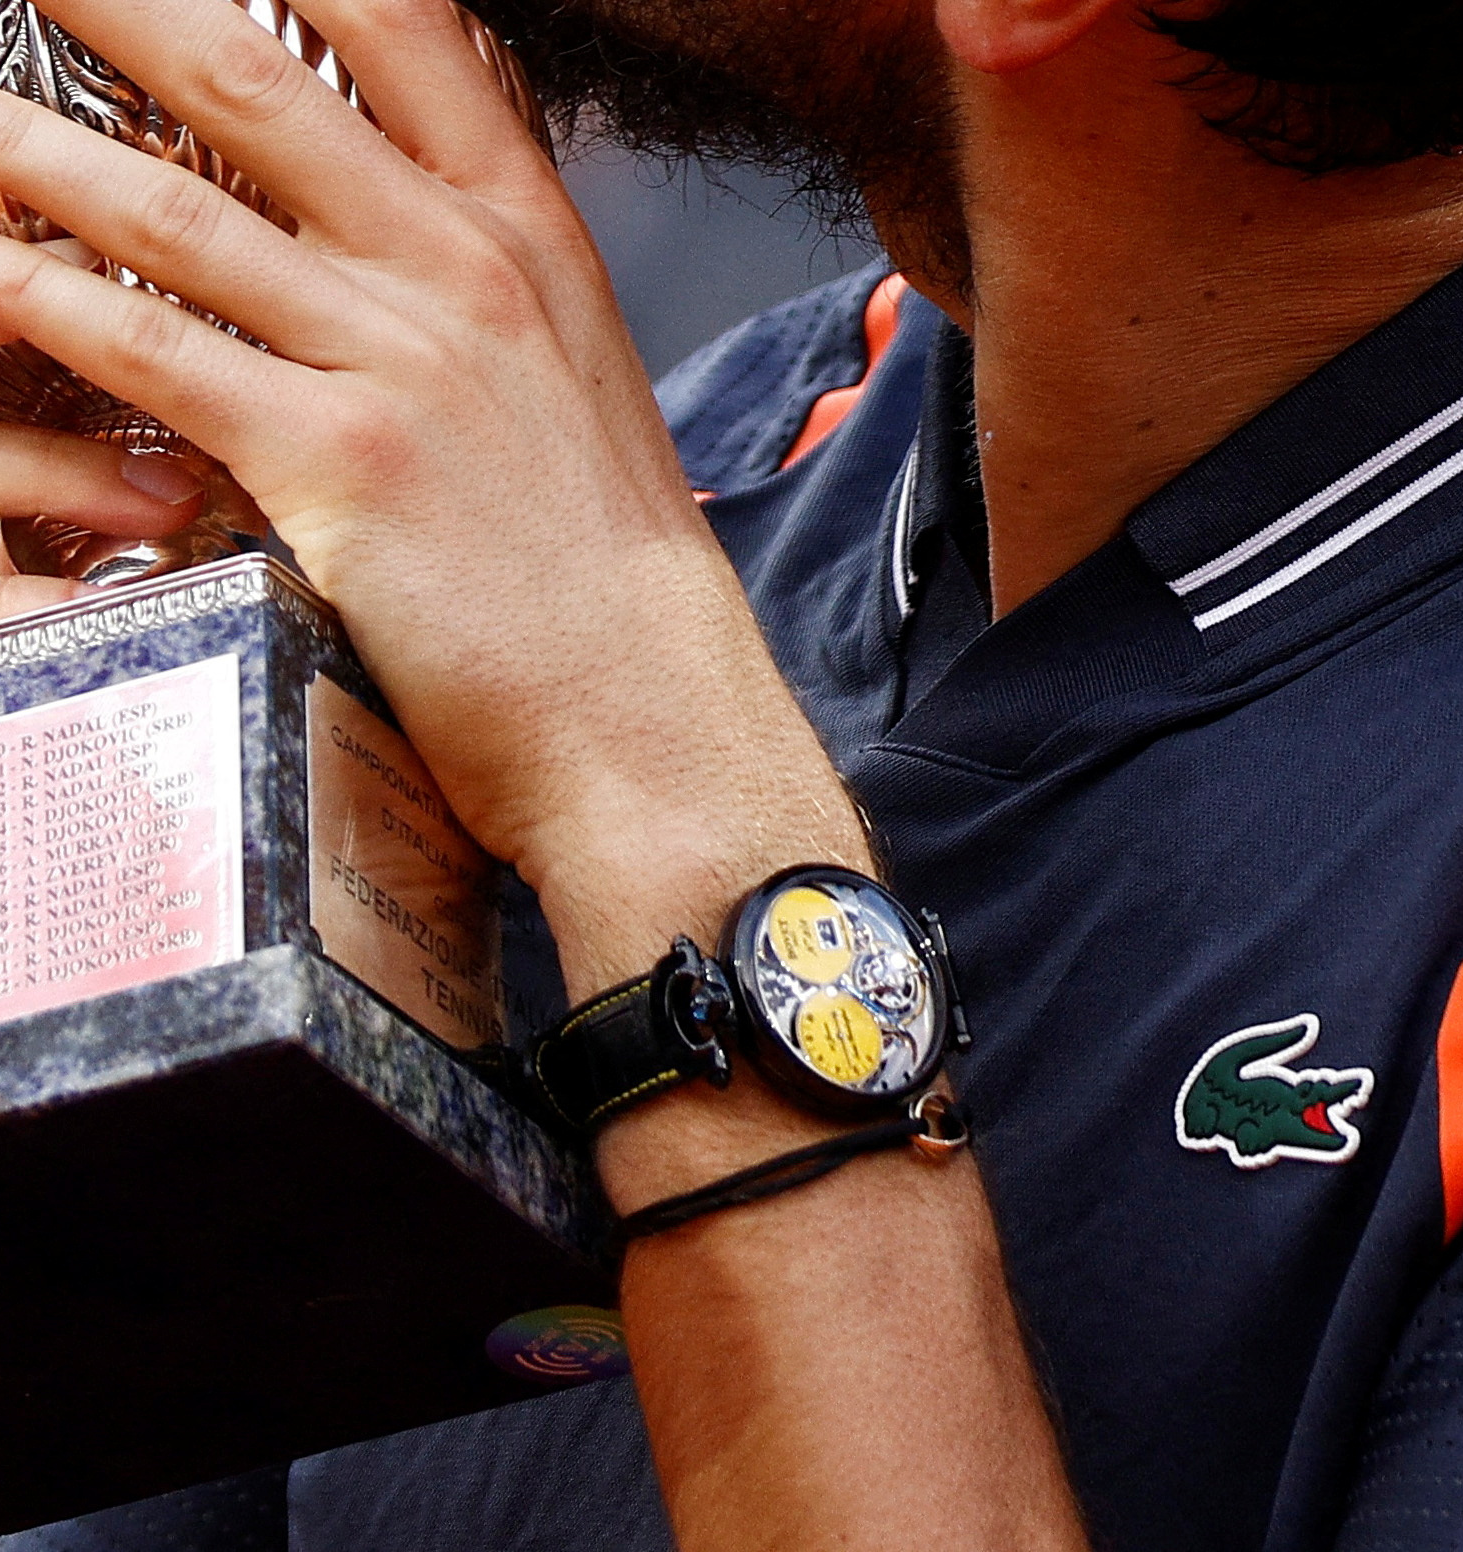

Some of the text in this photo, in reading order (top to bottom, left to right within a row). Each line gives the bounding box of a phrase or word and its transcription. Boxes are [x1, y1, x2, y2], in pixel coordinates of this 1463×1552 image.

[20, 752, 37, 772] N.
[43, 723, 140, 766] DJOKOVIC
[145, 709, 192, 739] (SRB)
[21, 732, 37, 752] R.
[43, 713, 106, 746] NADAL
[111, 699, 157, 728] (ESP)
[21, 772, 38, 791] R.
[43, 753, 107, 785] NADAL
[112, 738, 158, 767] (ESP)
[22, 791, 38, 811] R.
[44, 772, 107, 805] NADAL
[112, 757, 159, 787] (ESP)
[22, 810, 39, 831] N.
[44, 782, 141, 825] DJOKOVIC
[146, 767, 193, 798] (SRB)
[22, 830, 39, 851] N.
[45, 801, 141, 845] DJOKOVIC
[146, 787, 193, 818] (SRB)
[23, 849, 39, 870] A.
[45, 825, 127, 864] MURRAY
[132, 809, 183, 841] (GBR)
[23, 869, 39, 890] A.
[45, 847, 119, 884] ZVEREV
[125, 831, 176, 863] (GER)
[24, 889, 40, 910] R.
[46, 870, 109, 904] NADAL
[114, 855, 161, 886] (ESP)
[24, 909, 40, 929] R.
[46, 890, 109, 923] NADAL
[115, 875, 161, 905] (ESP)
[24, 928, 41, 949] N.
[46, 900, 143, 943] DJOKOVIC
[148, 885, 195, 916] (SRB)
[25, 948, 41, 968] R.
[47, 929, 110, 962] NADAL
[116, 914, 162, 944] (ESP)
[330, 853, 483, 990] FEDERAZIONE
[25, 967, 42, 988] N.
[47, 939, 144, 982] DJOKOVIC
[149, 924, 196, 955] (SRB)
[420, 964, 505, 1045] TENNIS
